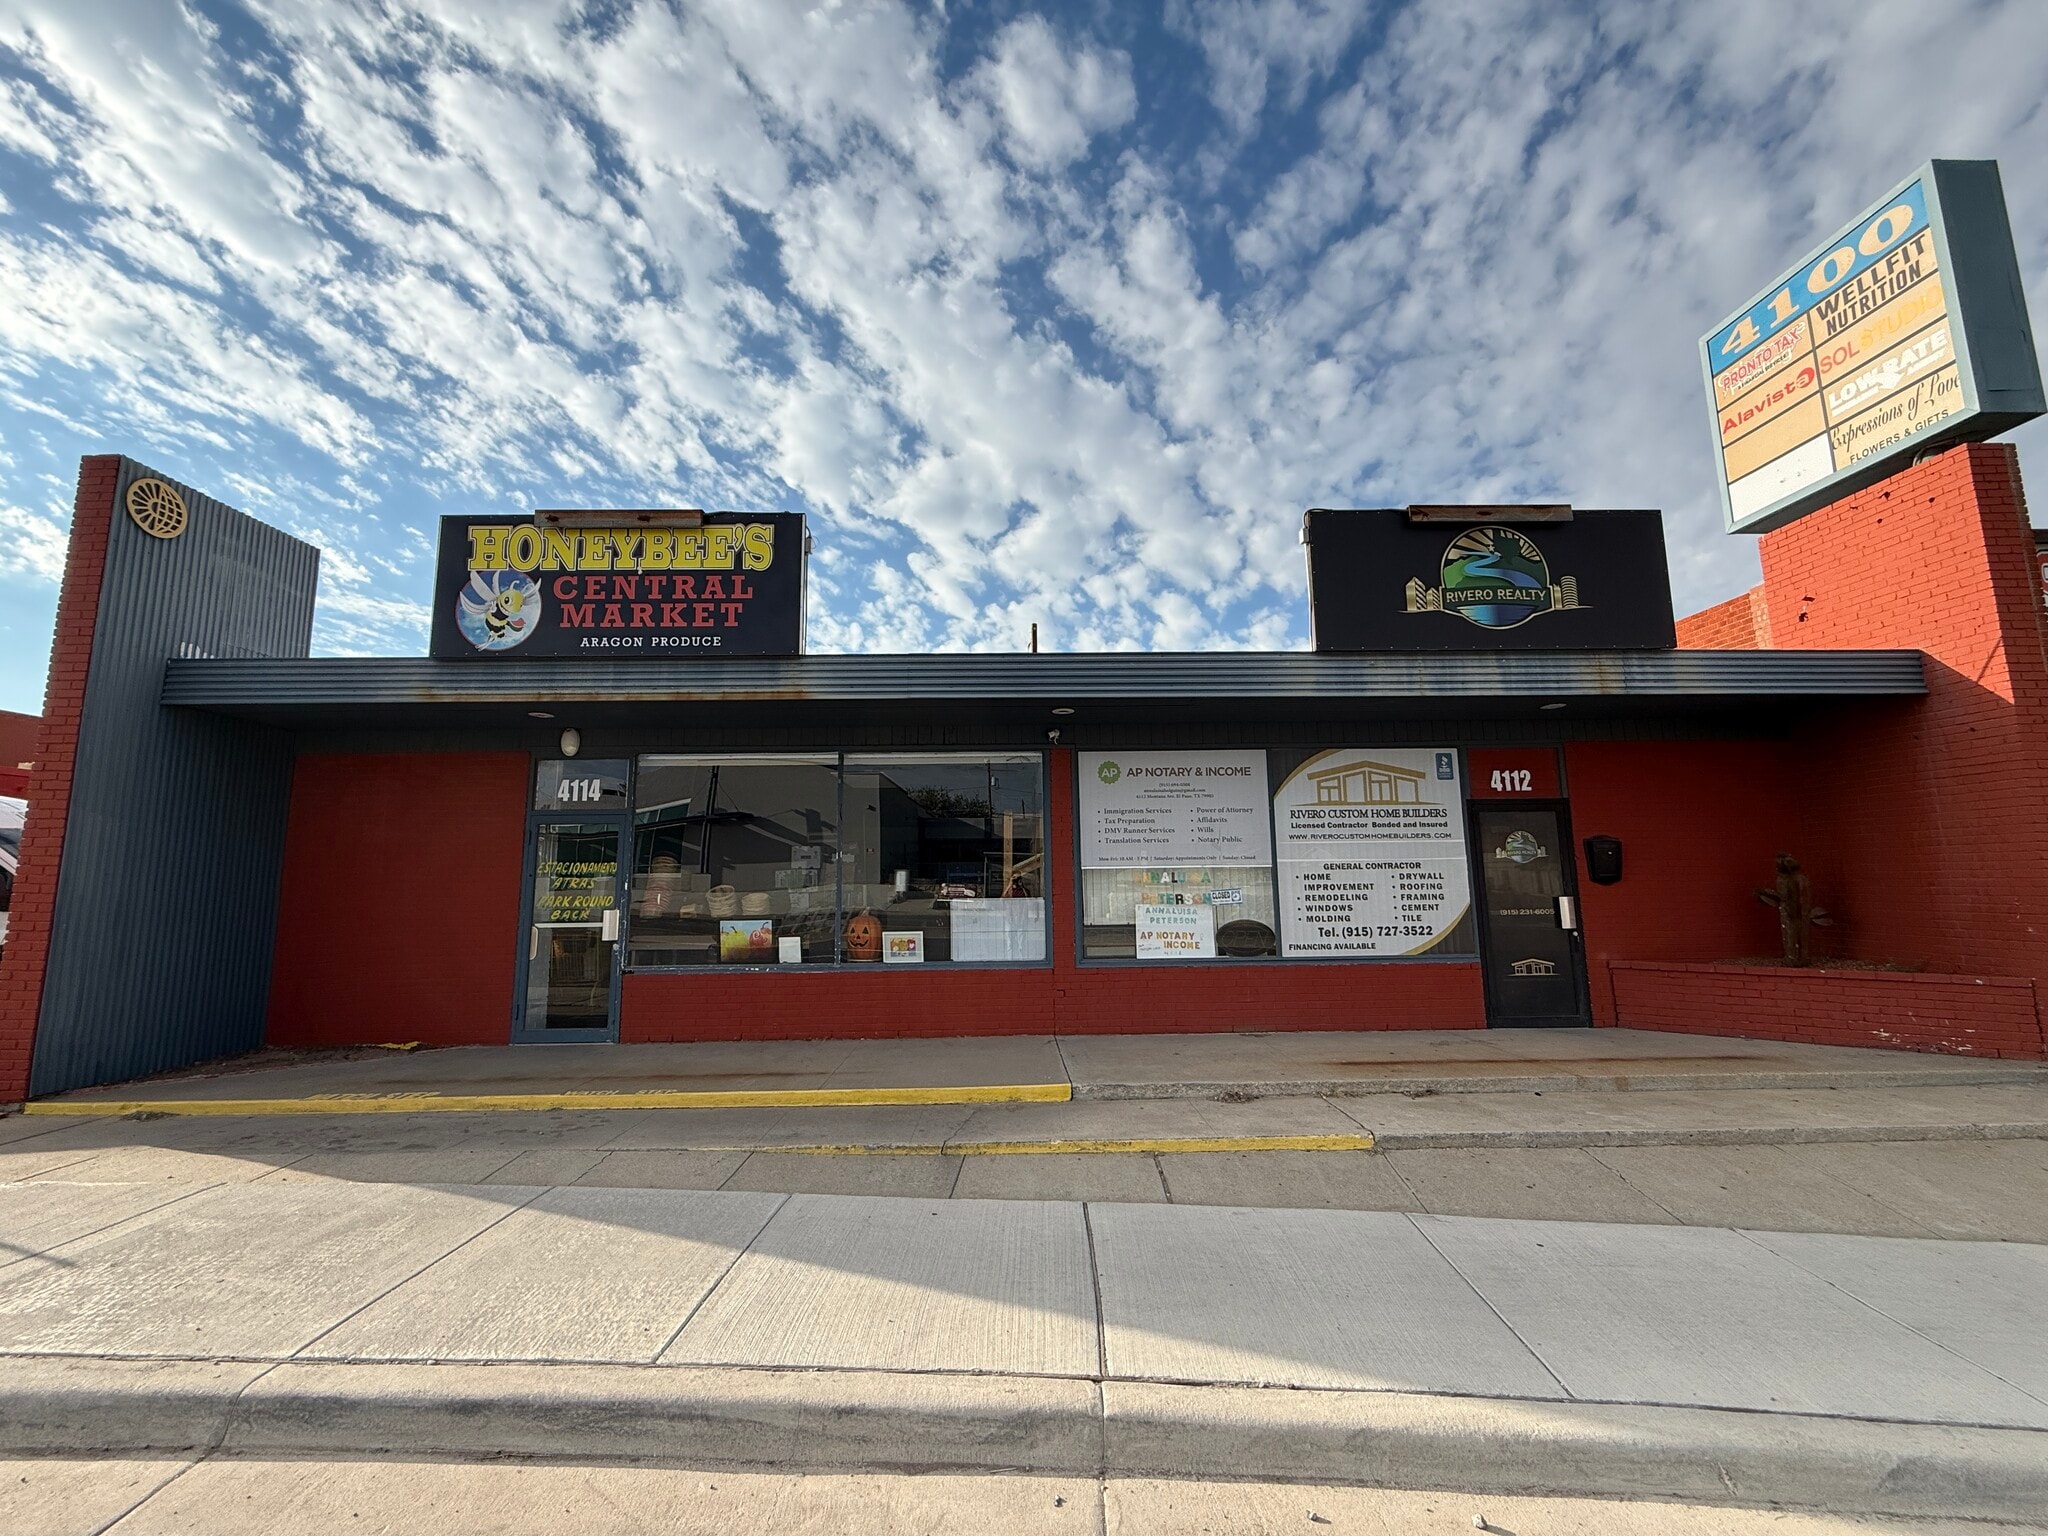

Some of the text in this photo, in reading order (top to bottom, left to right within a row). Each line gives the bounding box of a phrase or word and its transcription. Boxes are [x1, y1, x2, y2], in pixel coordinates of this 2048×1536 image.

[1721, 204, 1914, 356] 4100
[1816, 233, 1926, 321] WELLFIT
[1826, 259, 1921, 337] NUTRITION
[1820, 285, 1941, 374] SOL STUDIO
[1722, 328, 1799, 389] PRONTO TAX
[1832, 403, 1904, 453] Expressions
[1908, 382, 1925, 421] of
[1849, 409, 1949, 464] FLOWERS & GIFTS
[468, 523, 775, 572] HONEYBEE'S
[553, 575, 753, 600] CENTRAL
[1446, 588, 1546, 603] RIVERO REALTY
[560, 602, 744, 628] MARKET
[580, 636, 722, 648] ARAGON PRODUCE
[1101, 768, 1118, 777] AP
[1127, 766, 1251, 777] AP NOTARY & INCOME
[1491, 769, 1532, 792] 4112
[557, 778, 601, 802] 4114
[1104, 808, 1144, 816] Immigration
[1290, 808, 1448, 819] RIVERO CUSTOM HOME BUILDERS
[1198, 836, 1220, 844] Notary
[1323, 862, 1422, 870] GENERAL CONTRACTOR
[1303, 873, 1331, 881] HOME
[552, 877, 597, 889] ATRAS
[1304, 883, 1374, 891] IMPROVEMENT
[1212, 891, 1231, 900] CLOSED
[1305, 894, 1368, 902] REMODELING
[1400, 893, 1445, 901] FRAMING
[537, 895, 614, 908] PARK ROUND
[1145, 907, 1198, 915] ANNALUISA
[1305, 904, 1353, 912] WINDOWS
[551, 908, 591, 920] BACK
[1402, 914, 1422, 922] TILE
[1150, 917, 1197, 925] PETERSON
[1140, 931, 1195, 940] AP NOTARY
[1318, 925, 1433, 939] Tel. (915) 727-3522
[1163, 940, 1201, 950] INCOME
[1288, 942, 1376, 951] FINANCING AVAILABLE
